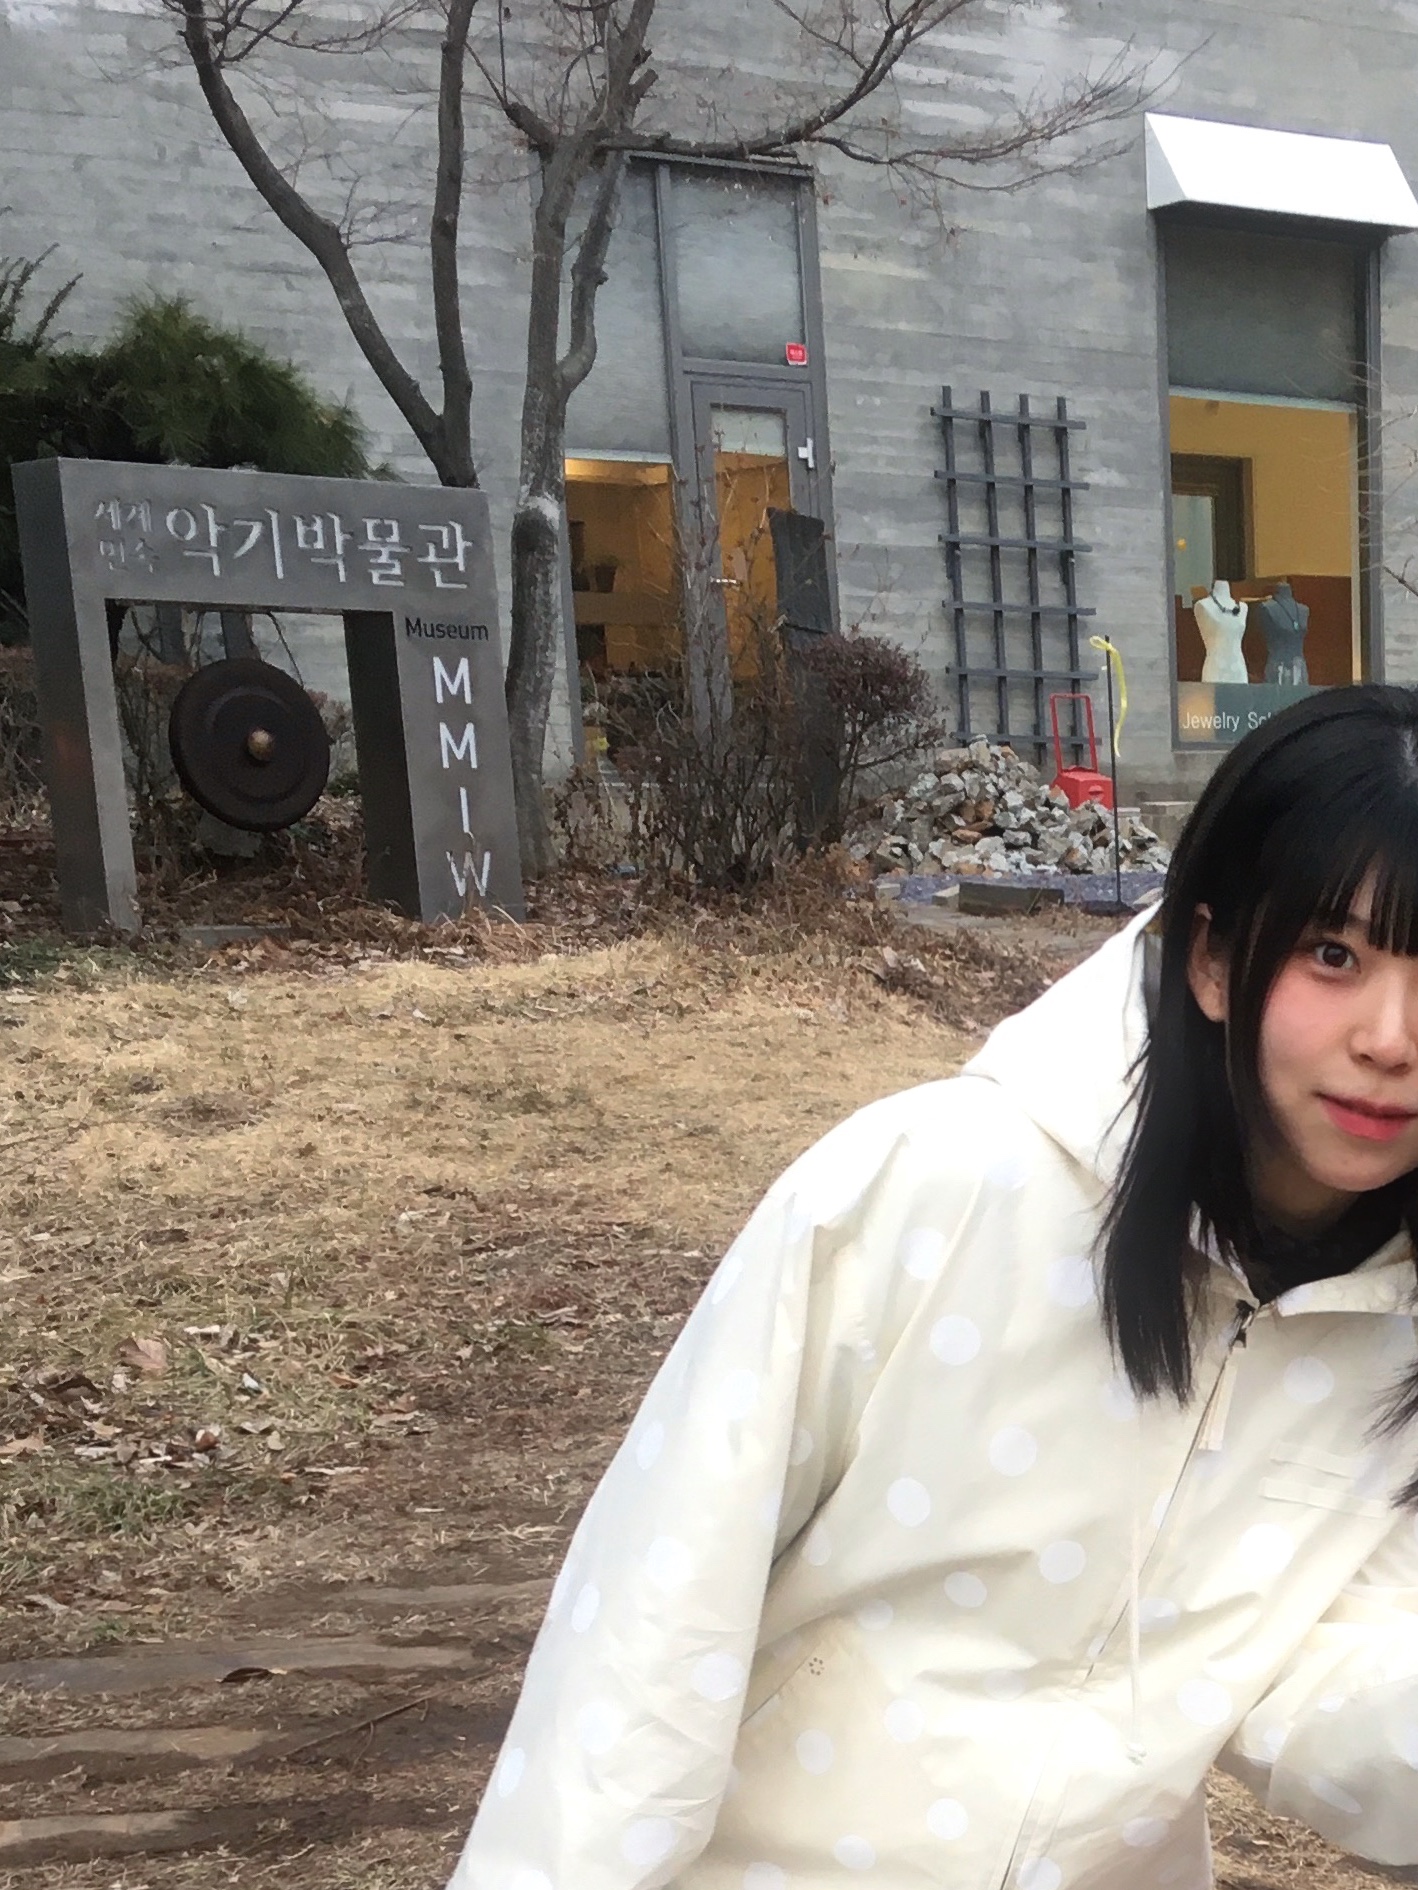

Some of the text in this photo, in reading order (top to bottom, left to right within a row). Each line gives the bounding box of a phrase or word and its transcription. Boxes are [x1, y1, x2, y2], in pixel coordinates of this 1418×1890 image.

[94, 500, 152, 532] 세계
[165, 503, 473, 590] 악기박물관
[405, 617, 489, 641] Museum
[1182, 711, 1240, 732] Jewelry
